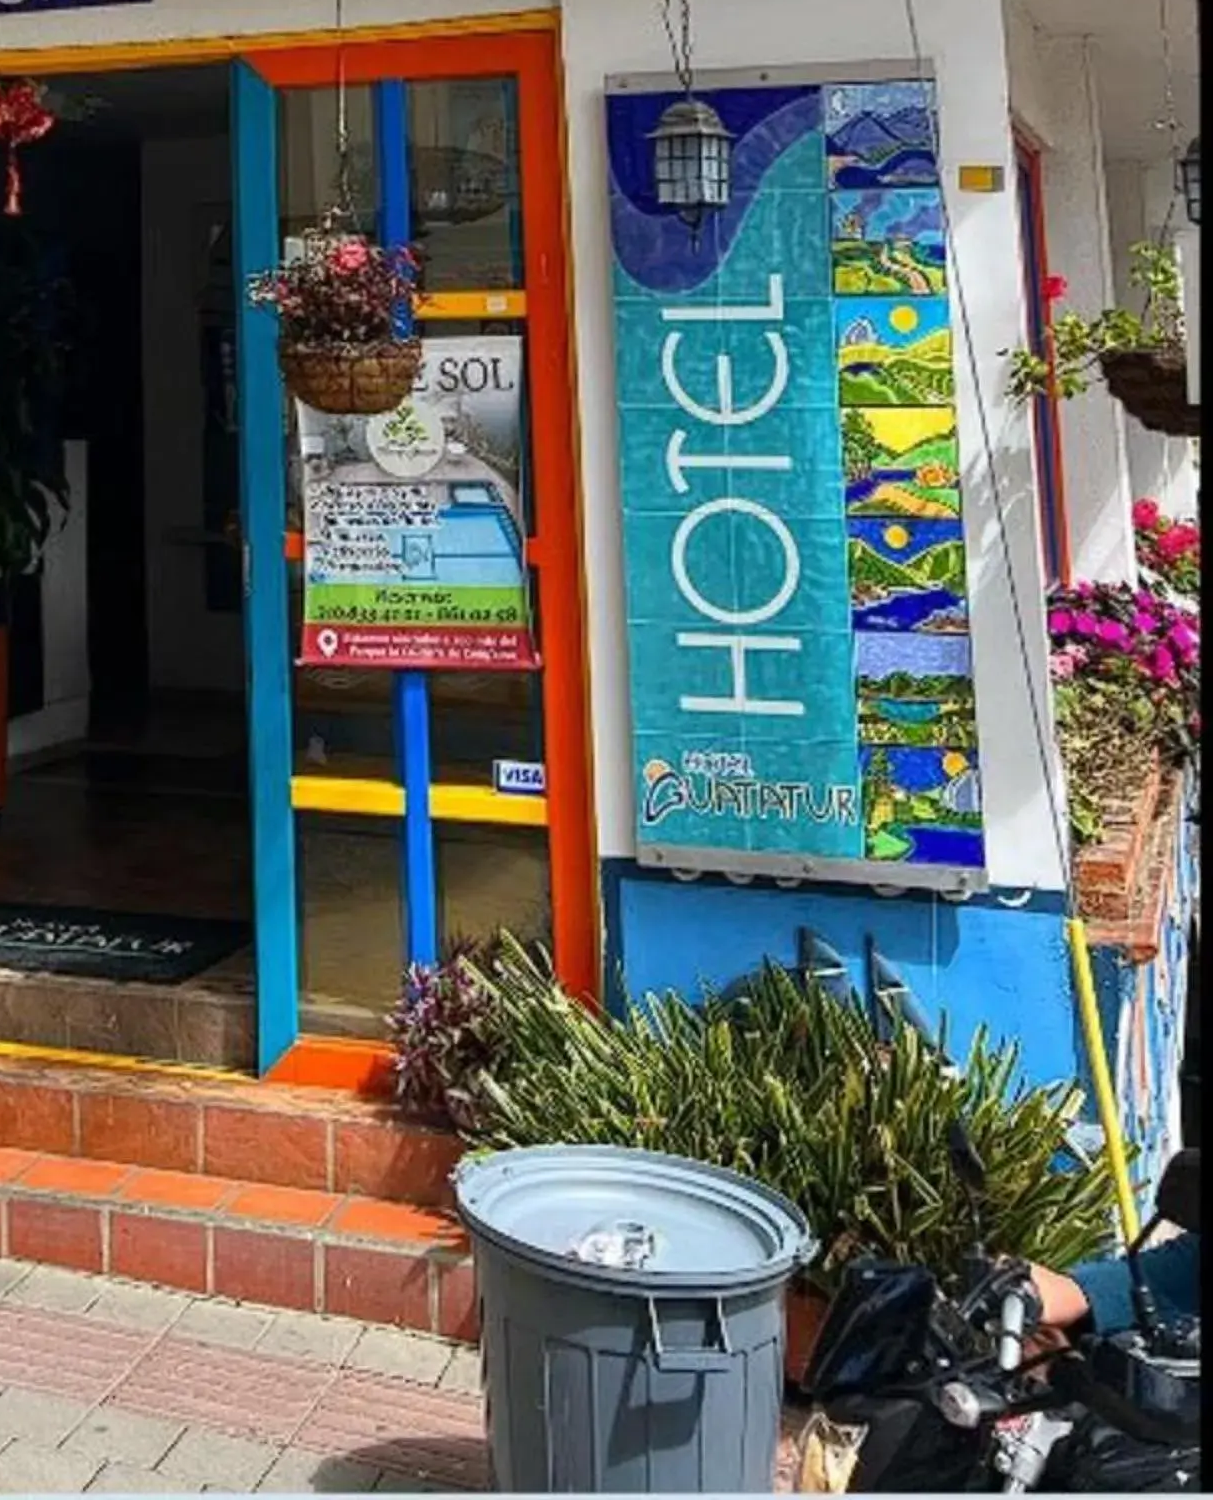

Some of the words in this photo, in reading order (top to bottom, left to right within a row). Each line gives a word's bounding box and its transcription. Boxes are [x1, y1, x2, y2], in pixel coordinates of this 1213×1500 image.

[437, 357, 514, 393] SOL
[661, 274, 805, 716] HOTEL
[644, 772, 858, 825] GUATATUR
